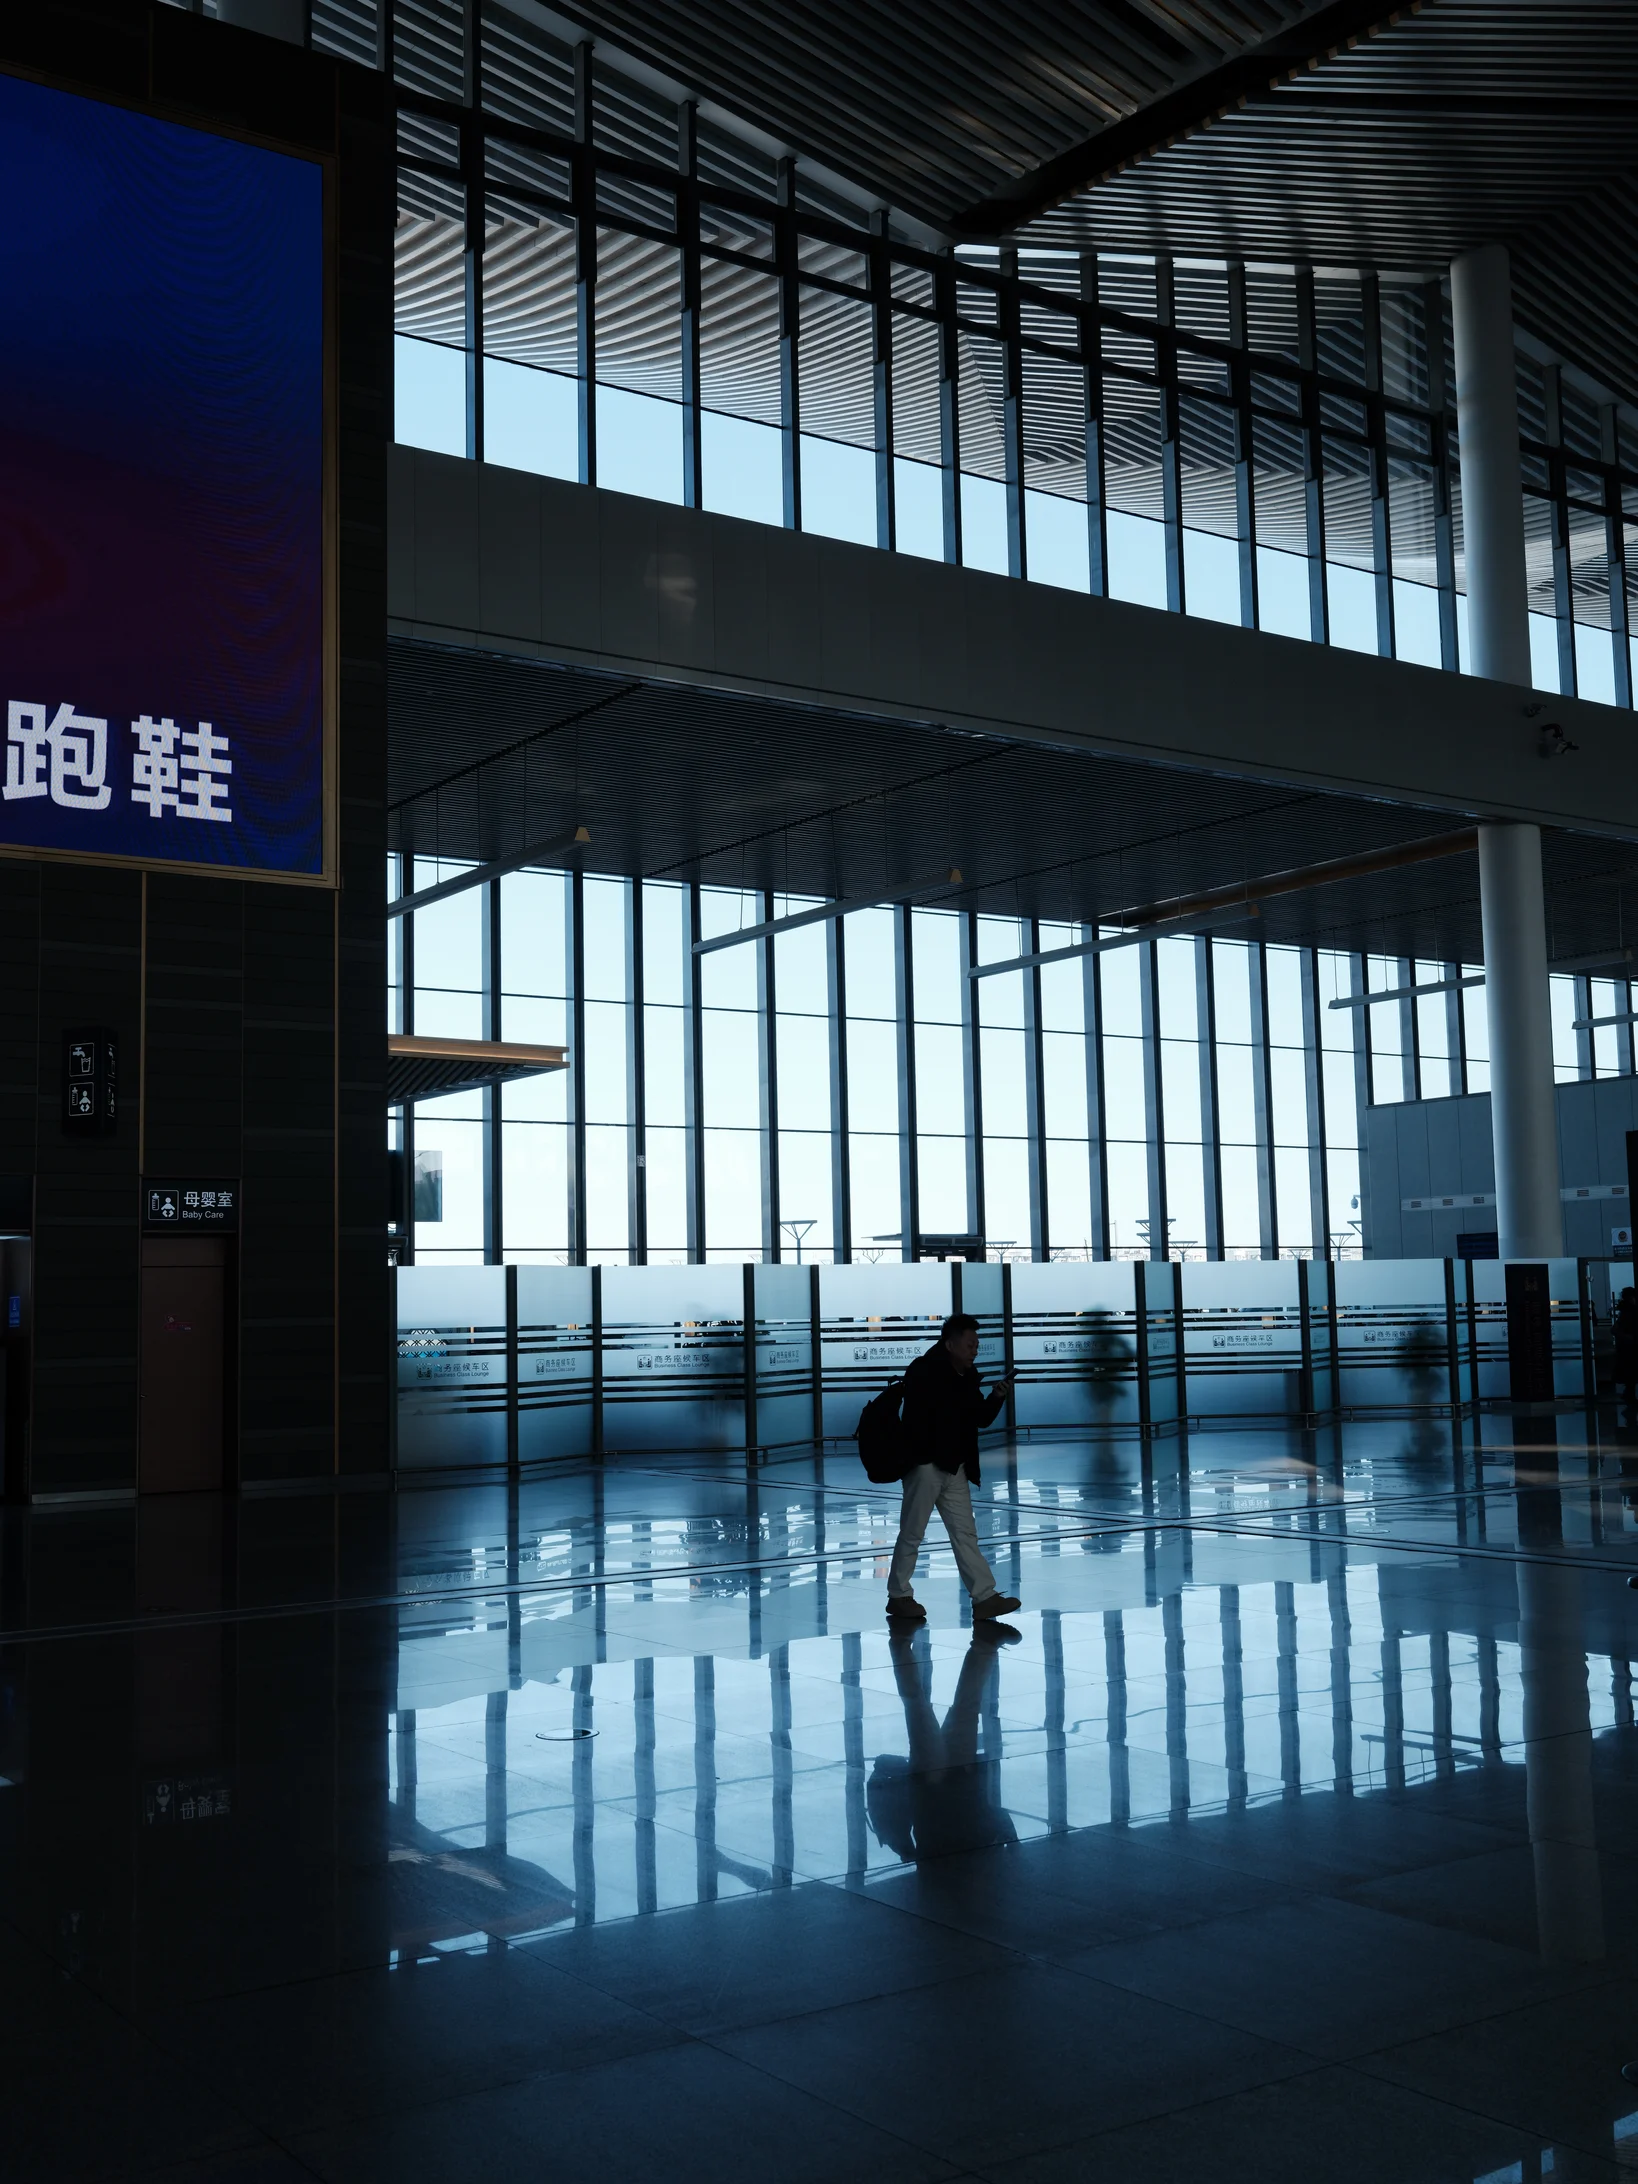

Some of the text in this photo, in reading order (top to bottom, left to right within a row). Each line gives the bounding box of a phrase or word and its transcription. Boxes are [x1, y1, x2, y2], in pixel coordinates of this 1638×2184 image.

[2, 700, 232, 823] 跑鞋
[184, 1191, 233, 1208] 母婴室
[182, 1210, 224, 1220] Baby Care
